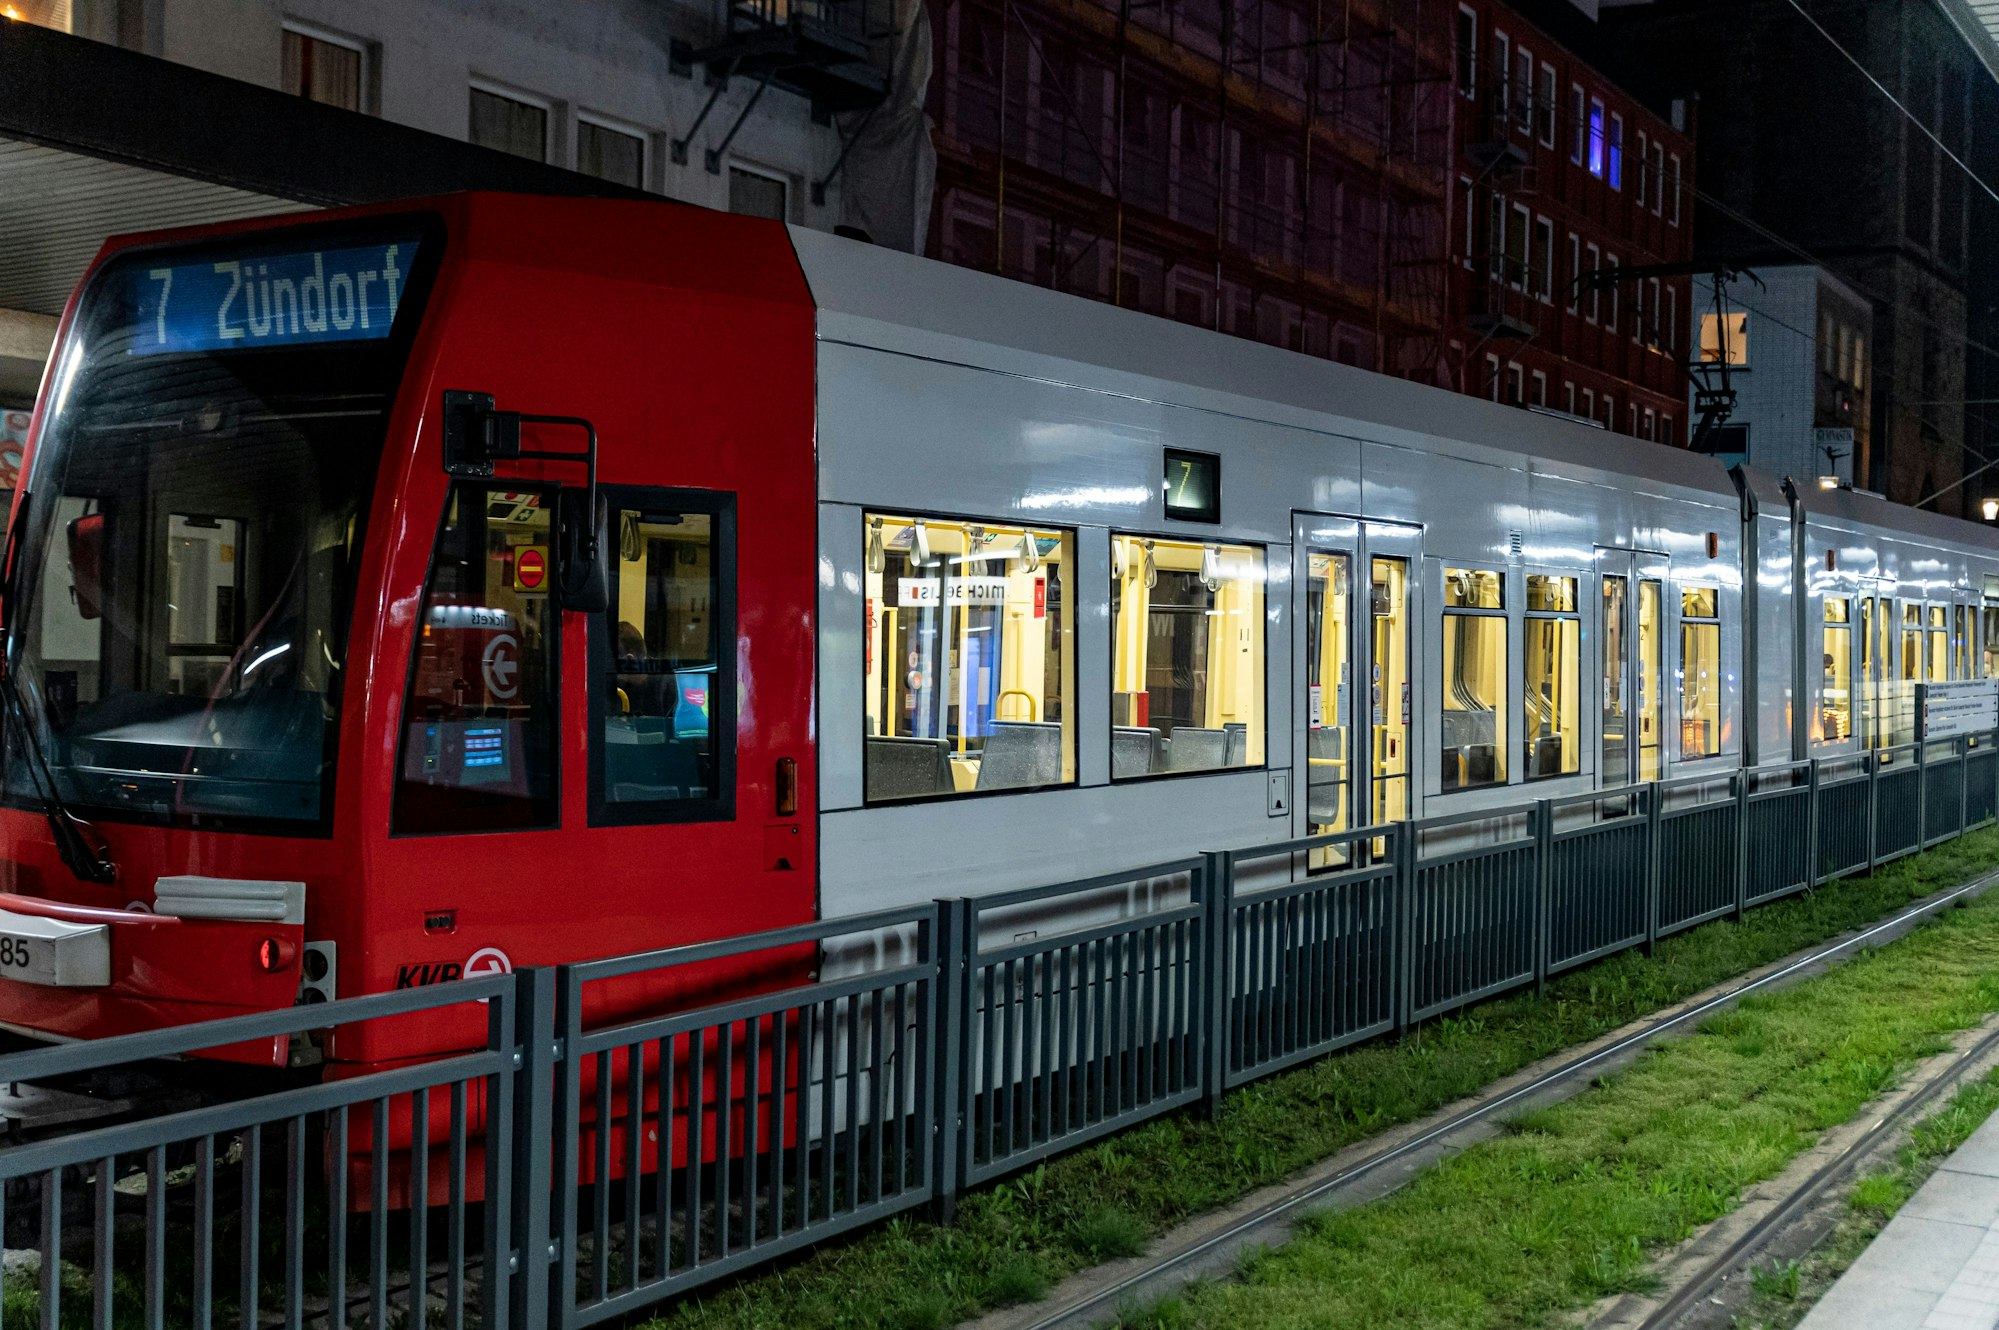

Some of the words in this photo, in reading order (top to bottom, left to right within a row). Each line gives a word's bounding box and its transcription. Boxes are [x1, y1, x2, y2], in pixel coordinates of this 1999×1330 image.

[150, 268, 173, 344] 7
[214, 244, 400, 339] Zündorf
[1177, 461, 1191, 507] 7
[0, 937, 30, 968] 85
